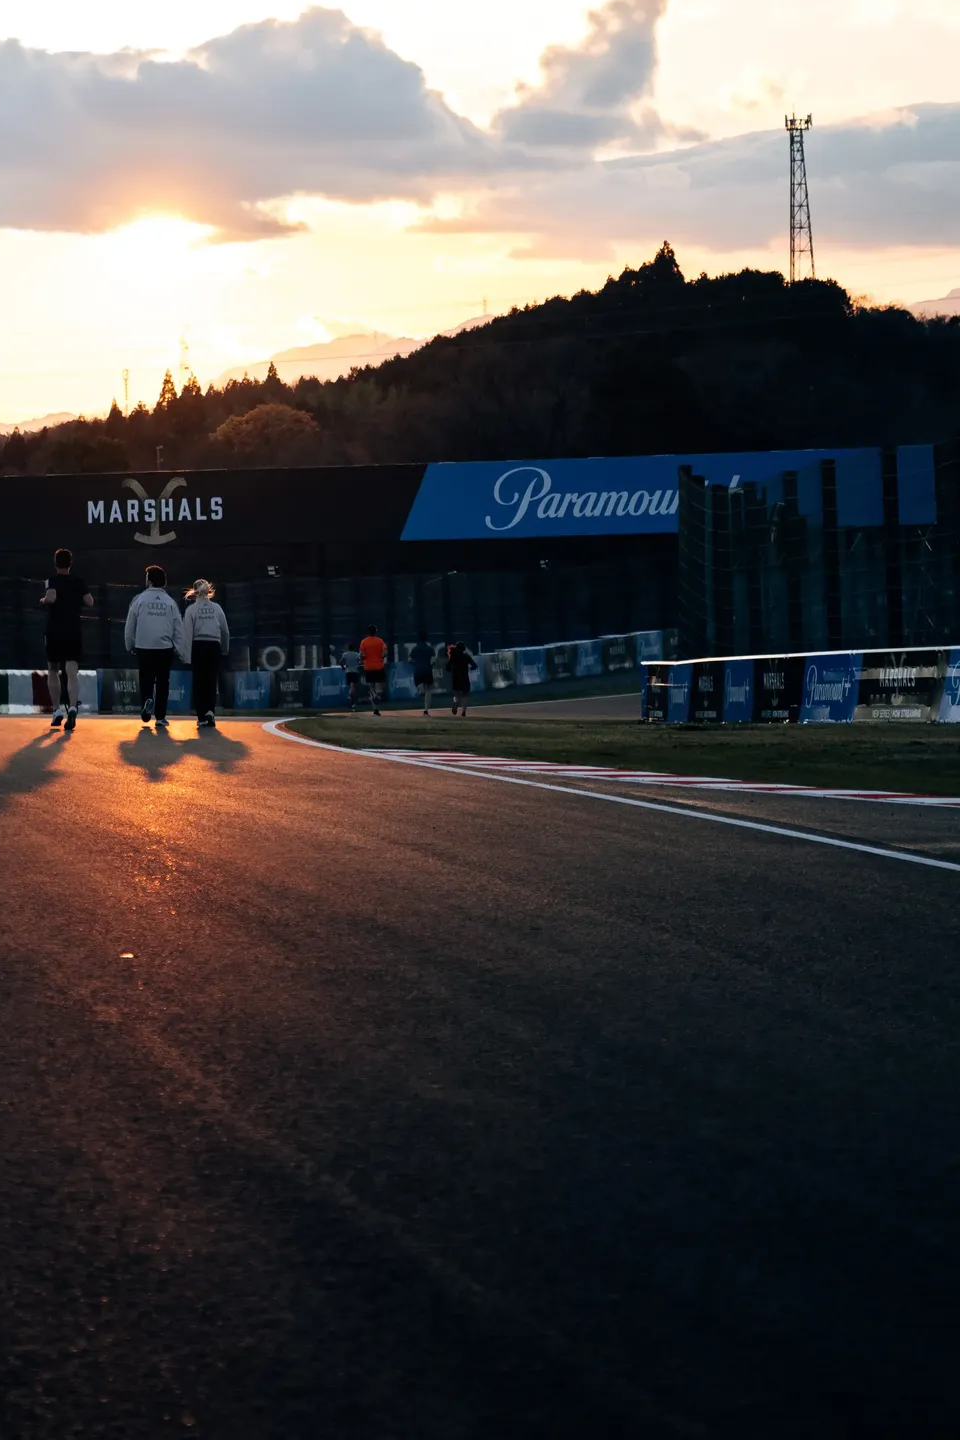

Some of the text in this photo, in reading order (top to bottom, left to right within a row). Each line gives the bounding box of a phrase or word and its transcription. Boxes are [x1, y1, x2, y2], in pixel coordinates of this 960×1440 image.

[87, 496, 224, 524] MARSHALS
[485, 467, 744, 531] Paramou
[879, 668, 917, 688] MARSHALS
